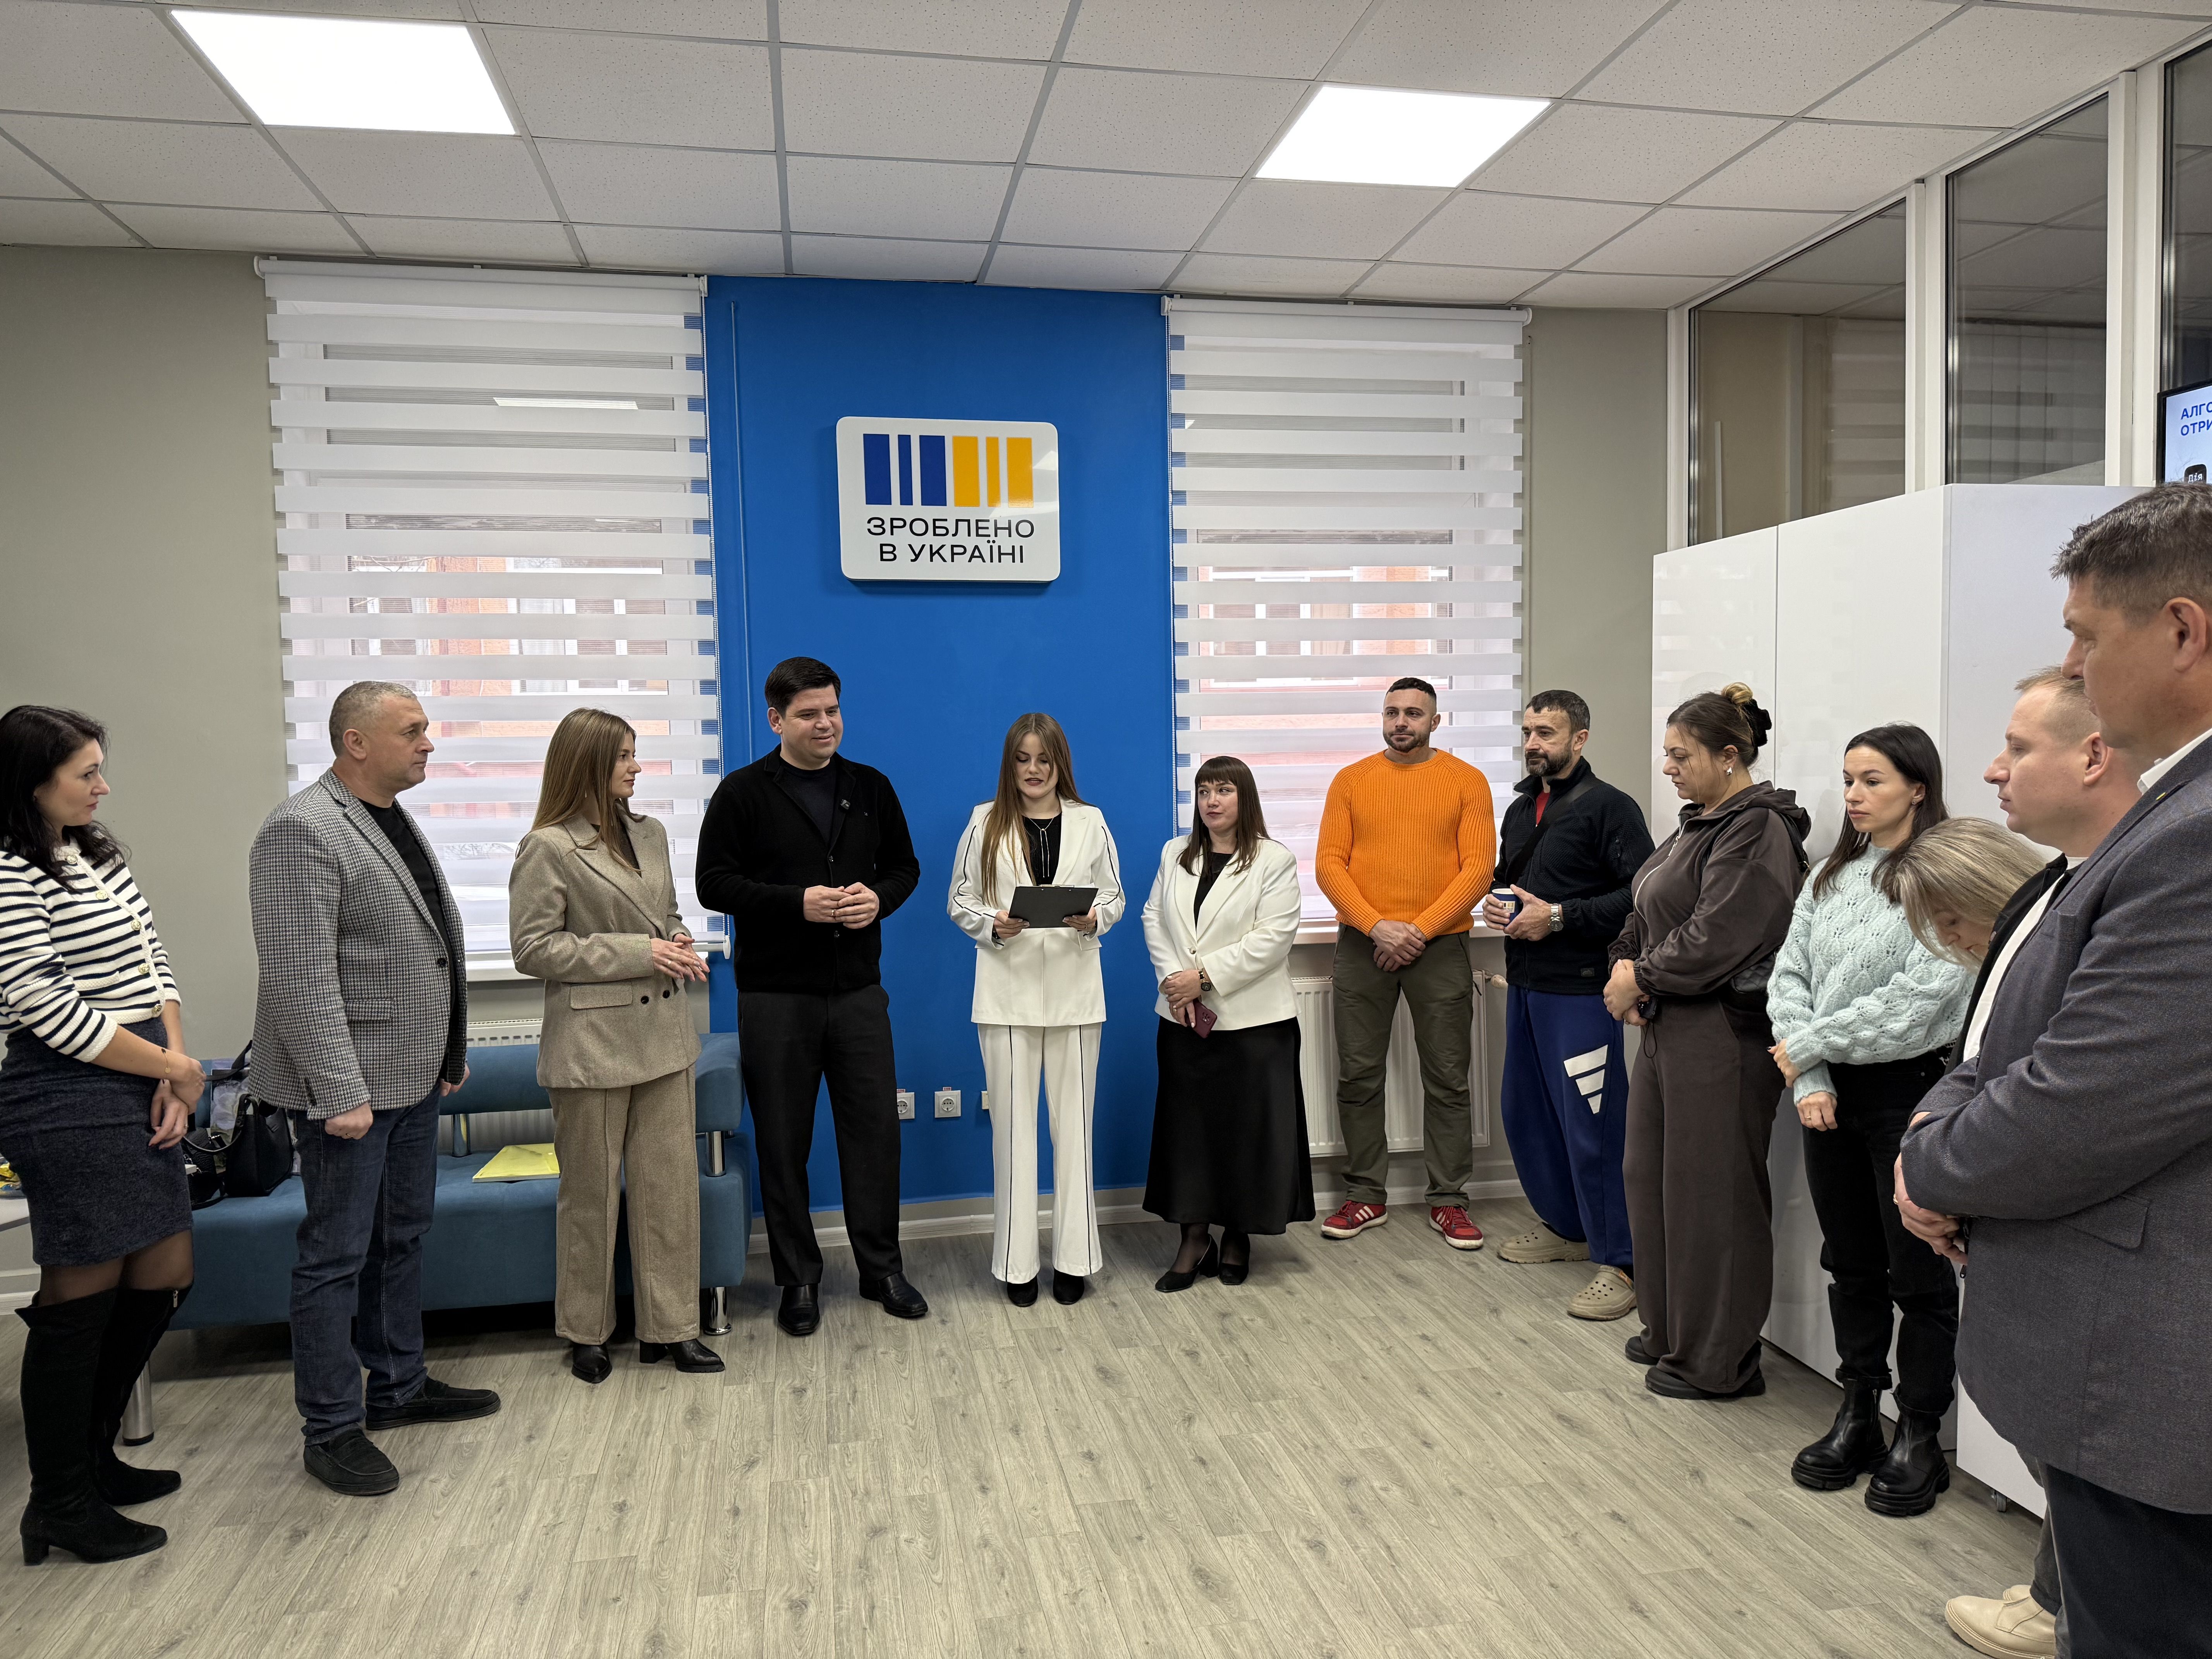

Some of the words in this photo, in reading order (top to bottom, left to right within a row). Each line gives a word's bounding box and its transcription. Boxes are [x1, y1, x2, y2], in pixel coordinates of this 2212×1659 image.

[2188, 472, 2203, 484] Дія
[867, 517, 1034, 538] ЗРОБЛЕНО
[879, 543, 897, 562] В
[907, 539, 1024, 563] УКРАЇНІ
